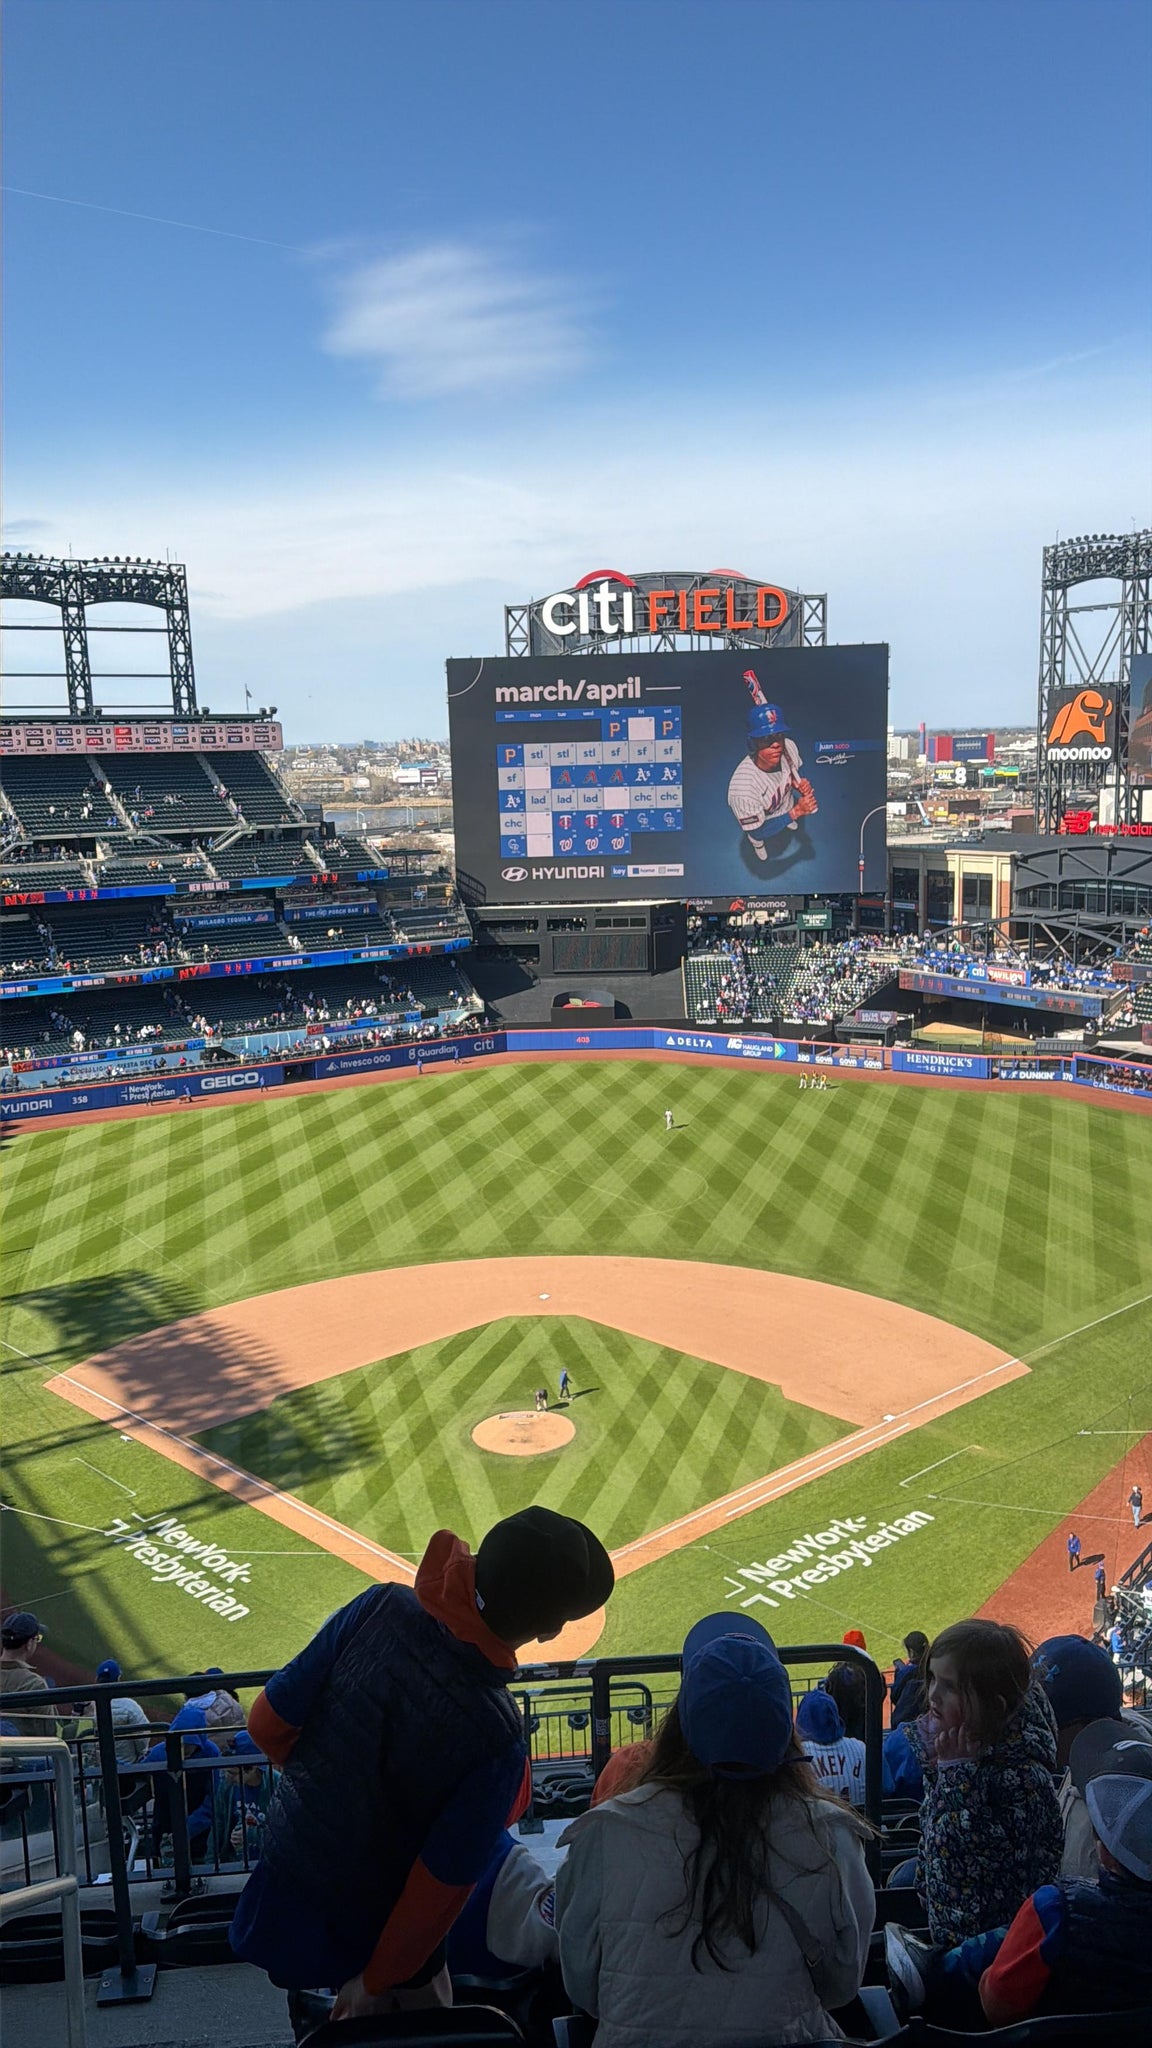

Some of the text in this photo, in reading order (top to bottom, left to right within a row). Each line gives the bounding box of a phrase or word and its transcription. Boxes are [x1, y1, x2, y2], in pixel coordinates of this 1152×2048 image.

[541, 580, 789, 636] citi FIELD
[495, 676, 641, 706] march/april
[610, 747, 621, 757] sf
[637, 746, 648, 756] sf
[663, 745, 674, 756] sf
[819, 743, 834, 751] juan
[530, 750, 543, 760] stl
[557, 748, 570, 758] stl
[583, 748, 596, 758] stl
[1048, 747, 1112, 760] moomoo
[507, 773, 517, 782] sf
[531, 796, 546, 805] lad
[557, 795, 572, 804] lad
[583, 794, 598, 803] lad
[634, 792, 652, 802] chc
[660, 792, 678, 801] chc
[504, 819, 522, 828] chc
[1094, 824, 1118, 834] new
[532, 866, 604, 880] HYUNDAI
[612, 866, 626, 876] key
[747, 900, 786, 908] moomoo
[226, 916, 252, 924] TEQUILA
[474, 1038, 494, 1052] citi
[678, 1036, 712, 1048] DELTA
[418, 1044, 458, 1058] Guardian
[340, 1057, 372, 1070] Invesco
[906, 1053, 973, 1068] HENDRICK'S
[200, 1071, 260, 1090] GEICO
[1020, 1072, 1055, 1080] DUNKIN'
[1092, 1081, 1134, 1094] CADILLAC
[72, 1096, 88, 1104] 358
[0, 1099, 52, 1114] YUNDAI
[766, 1510, 935, 1600] Presbyterian
[114, 1530, 250, 1622] Presbyterian
